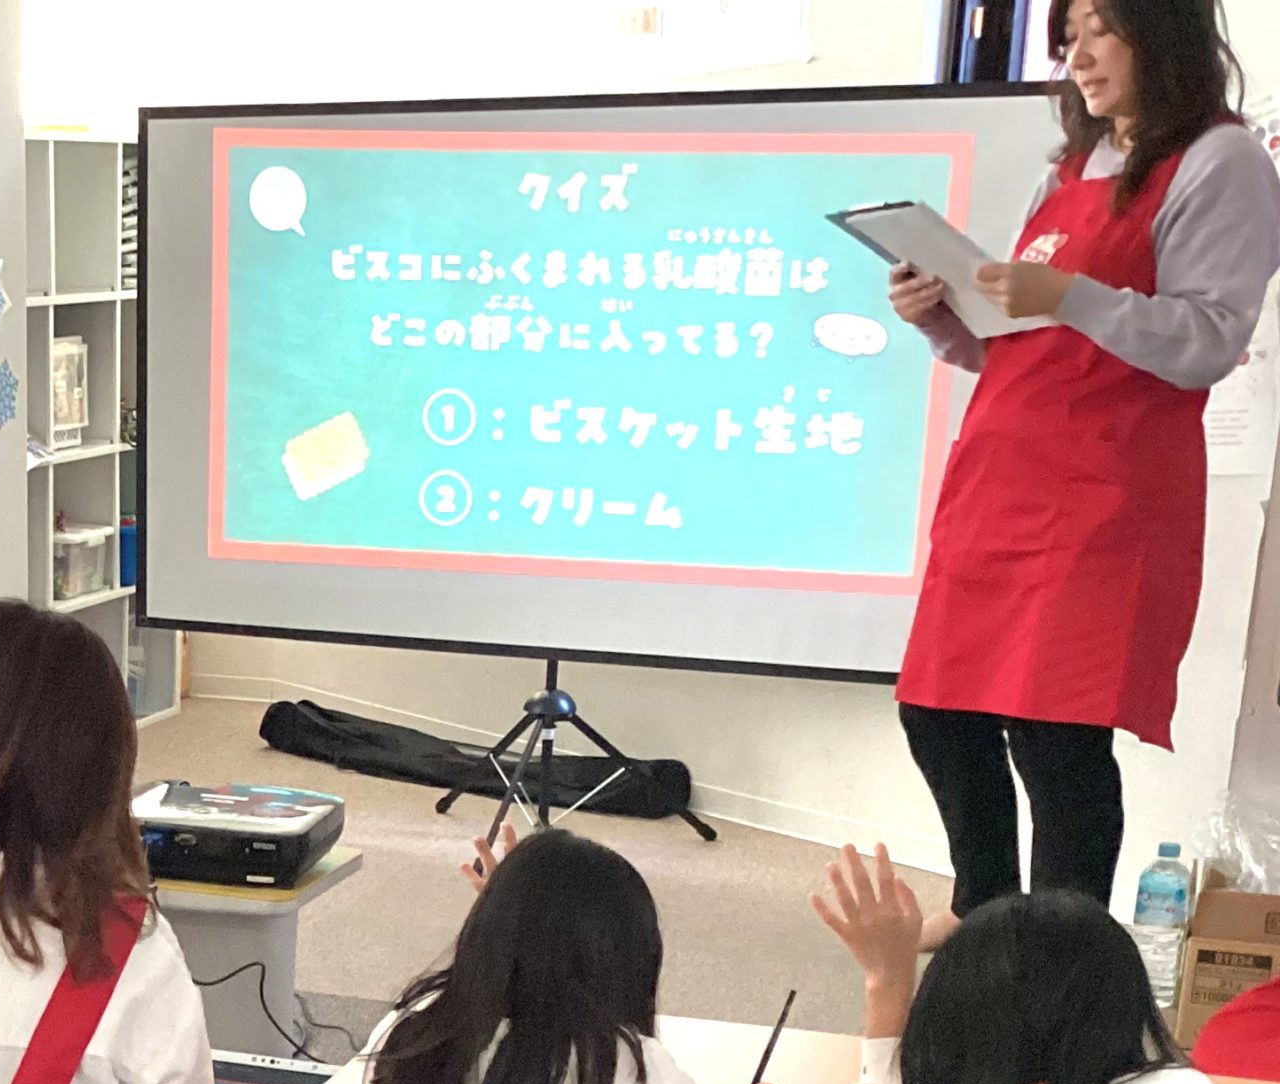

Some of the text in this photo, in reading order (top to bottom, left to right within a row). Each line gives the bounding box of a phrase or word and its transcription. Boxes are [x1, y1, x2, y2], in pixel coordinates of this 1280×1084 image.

[518, 162, 639, 213] クイズ
[331, 244, 830, 297] ビスコにふくまれる乳酸菌は
[370, 311, 775, 359] どこの部分に入ってる？
